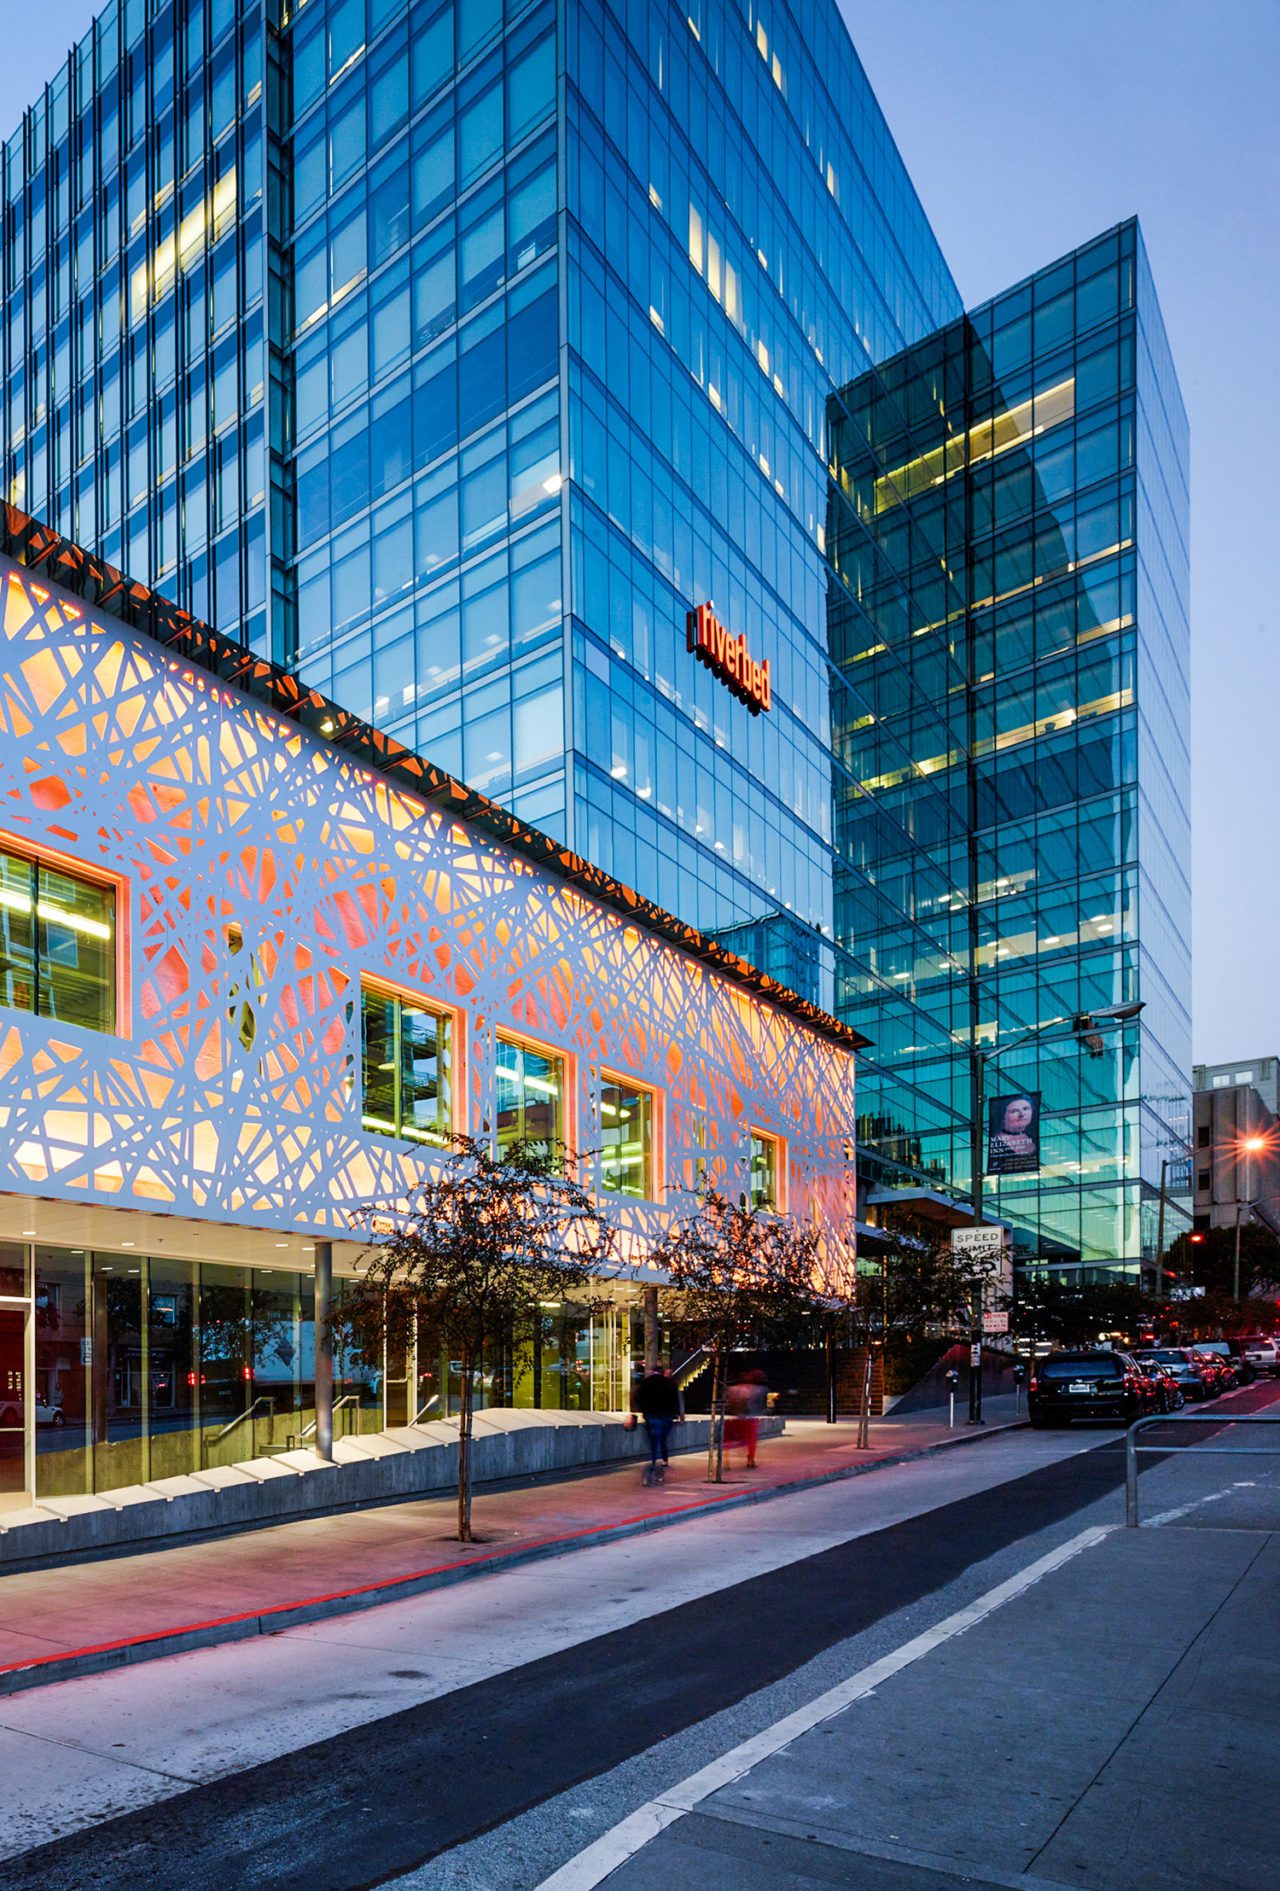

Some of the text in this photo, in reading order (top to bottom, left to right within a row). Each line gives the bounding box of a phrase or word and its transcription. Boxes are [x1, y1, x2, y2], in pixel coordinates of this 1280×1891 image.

[697, 600, 771, 713] riverbed
[990, 1138, 1033, 1149] ELIZABETH
[956, 1232, 999, 1243] SPEED
